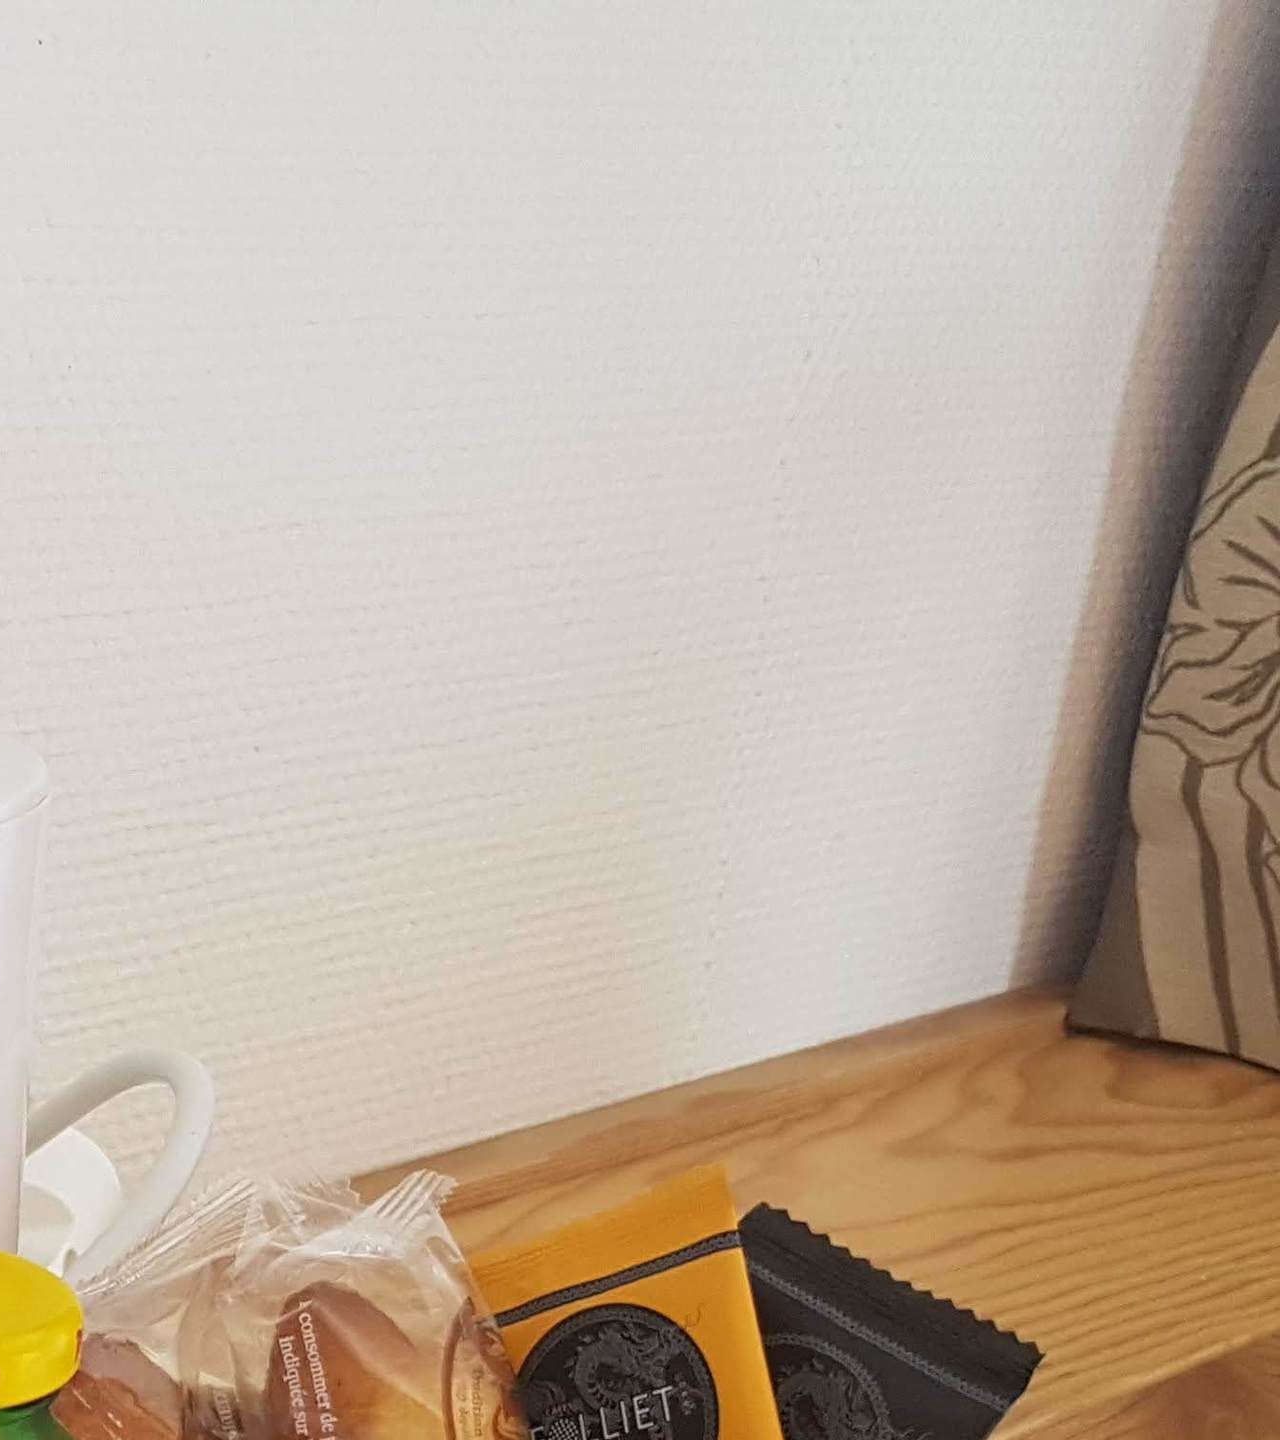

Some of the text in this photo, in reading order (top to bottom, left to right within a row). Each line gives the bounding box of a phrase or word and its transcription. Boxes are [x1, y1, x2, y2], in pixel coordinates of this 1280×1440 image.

[298, 1311, 330, 1410] consommer
[319, 1412, 338, 1434] de
[293, 1411, 309, 1436] sur
